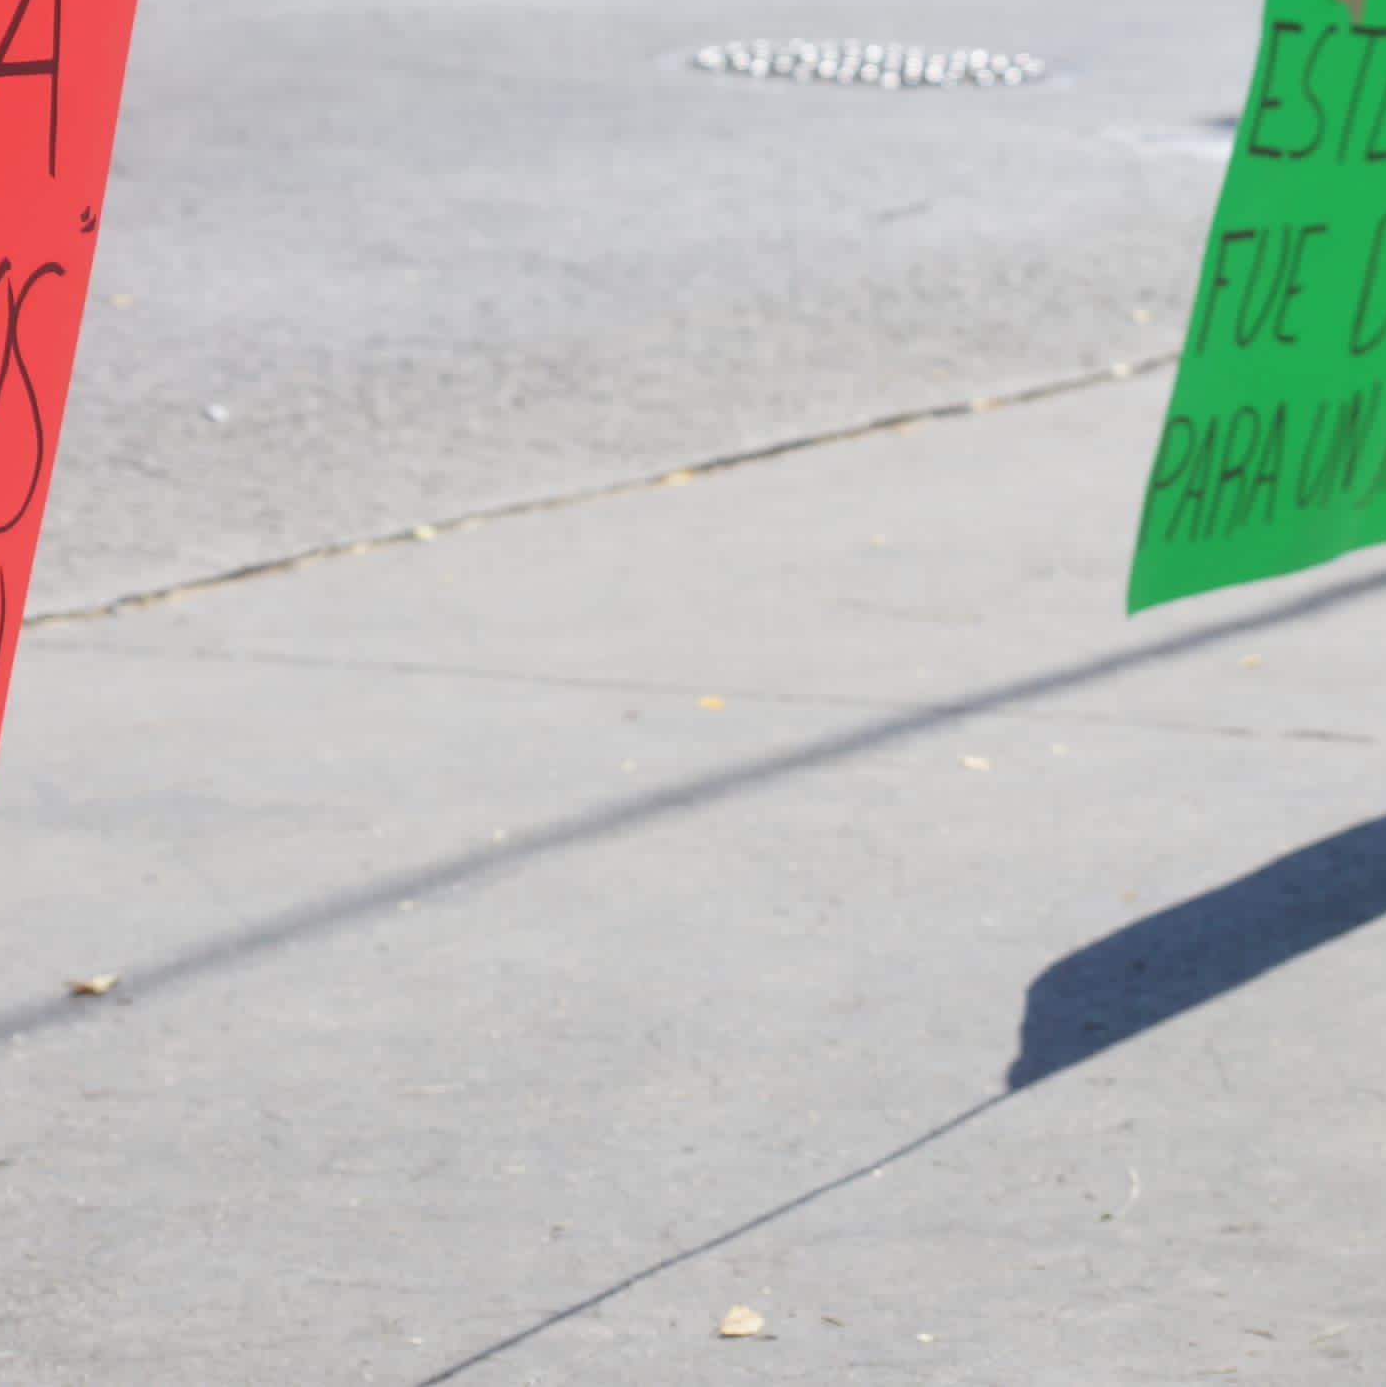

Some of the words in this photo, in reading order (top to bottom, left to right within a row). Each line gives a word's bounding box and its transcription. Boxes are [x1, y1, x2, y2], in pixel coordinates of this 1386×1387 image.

[1195, 222, 1329, 356] FUE
[1137, 400, 1289, 550] PARA
[1295, 378, 1384, 510] UN
